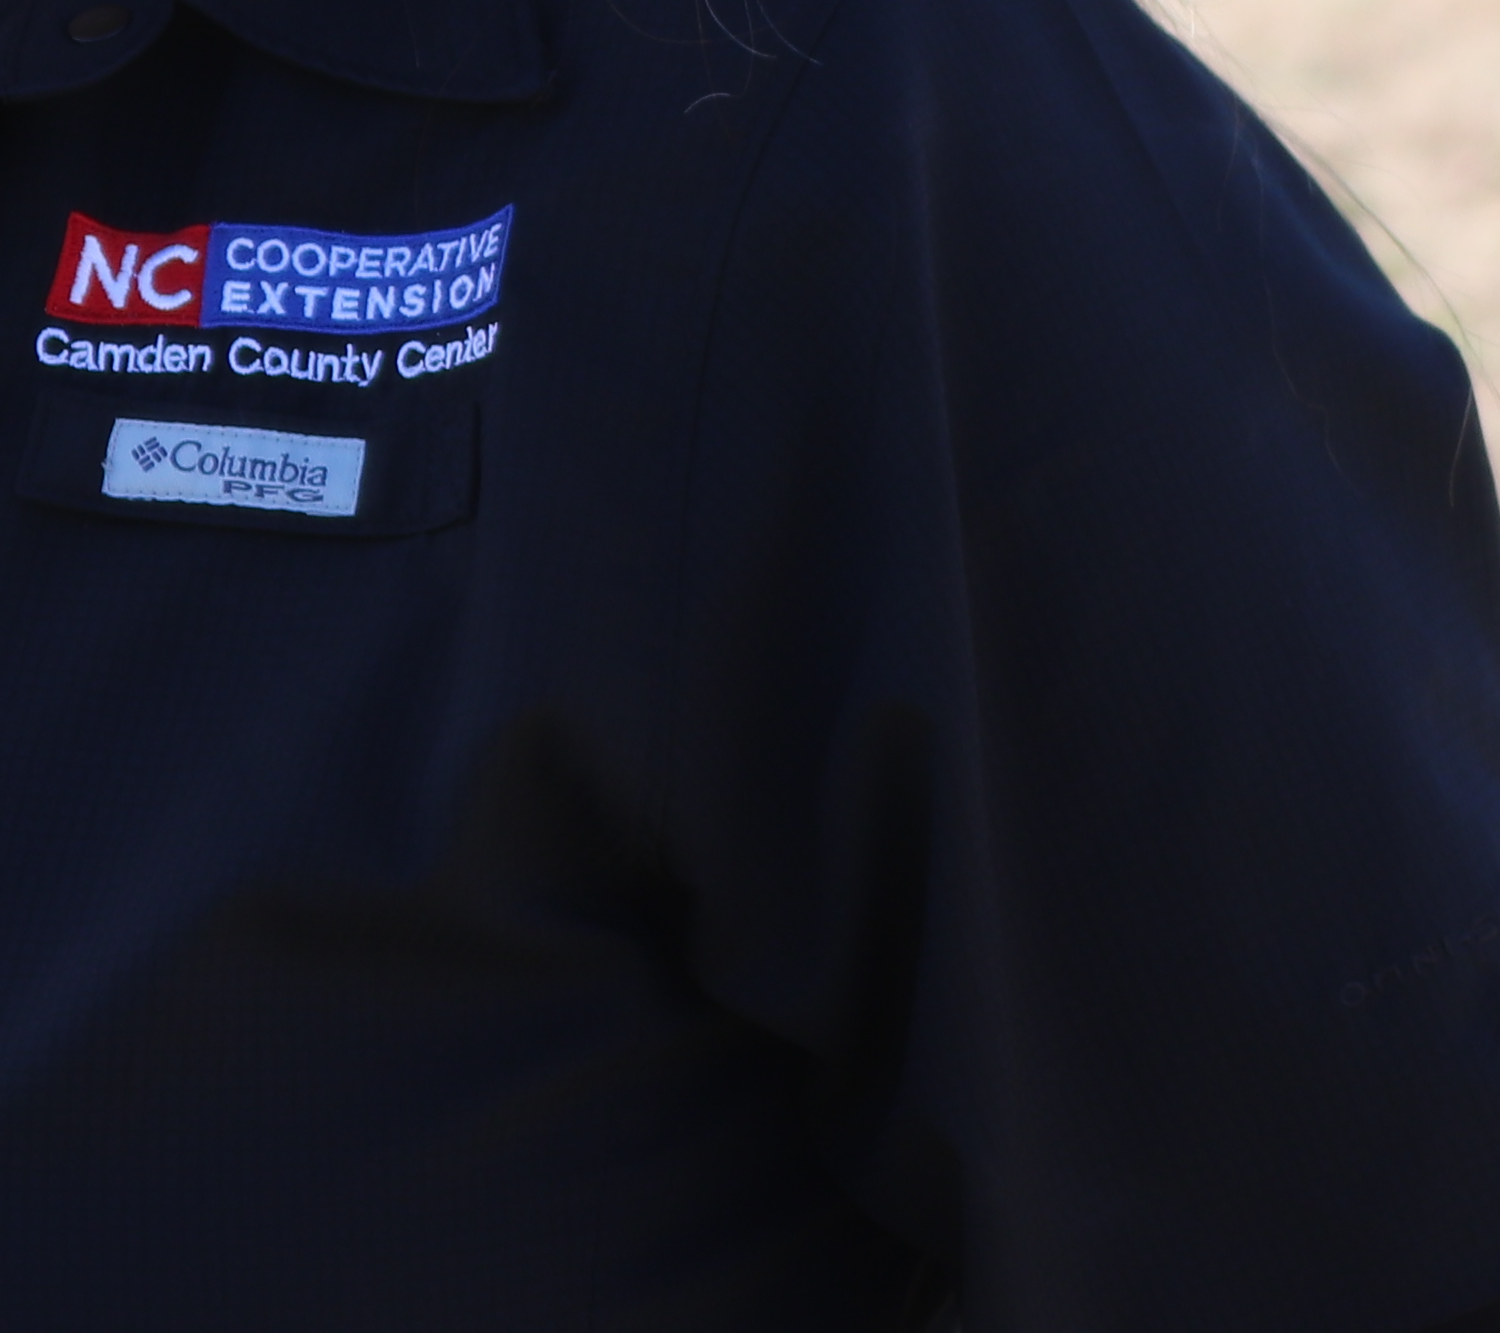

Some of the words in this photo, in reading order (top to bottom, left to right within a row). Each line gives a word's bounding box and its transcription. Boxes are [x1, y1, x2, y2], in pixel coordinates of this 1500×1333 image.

[70, 234, 198, 310] NC
[226, 222, 502, 278] COOPERATIVE
[221, 265, 496, 320] EXTENSION
[35, 327, 212, 374] Camden
[228, 336, 383, 387] County
[395, 321, 499, 379] Center
[168, 440, 329, 488] Columbia
[222, 479, 325, 504] PFG
